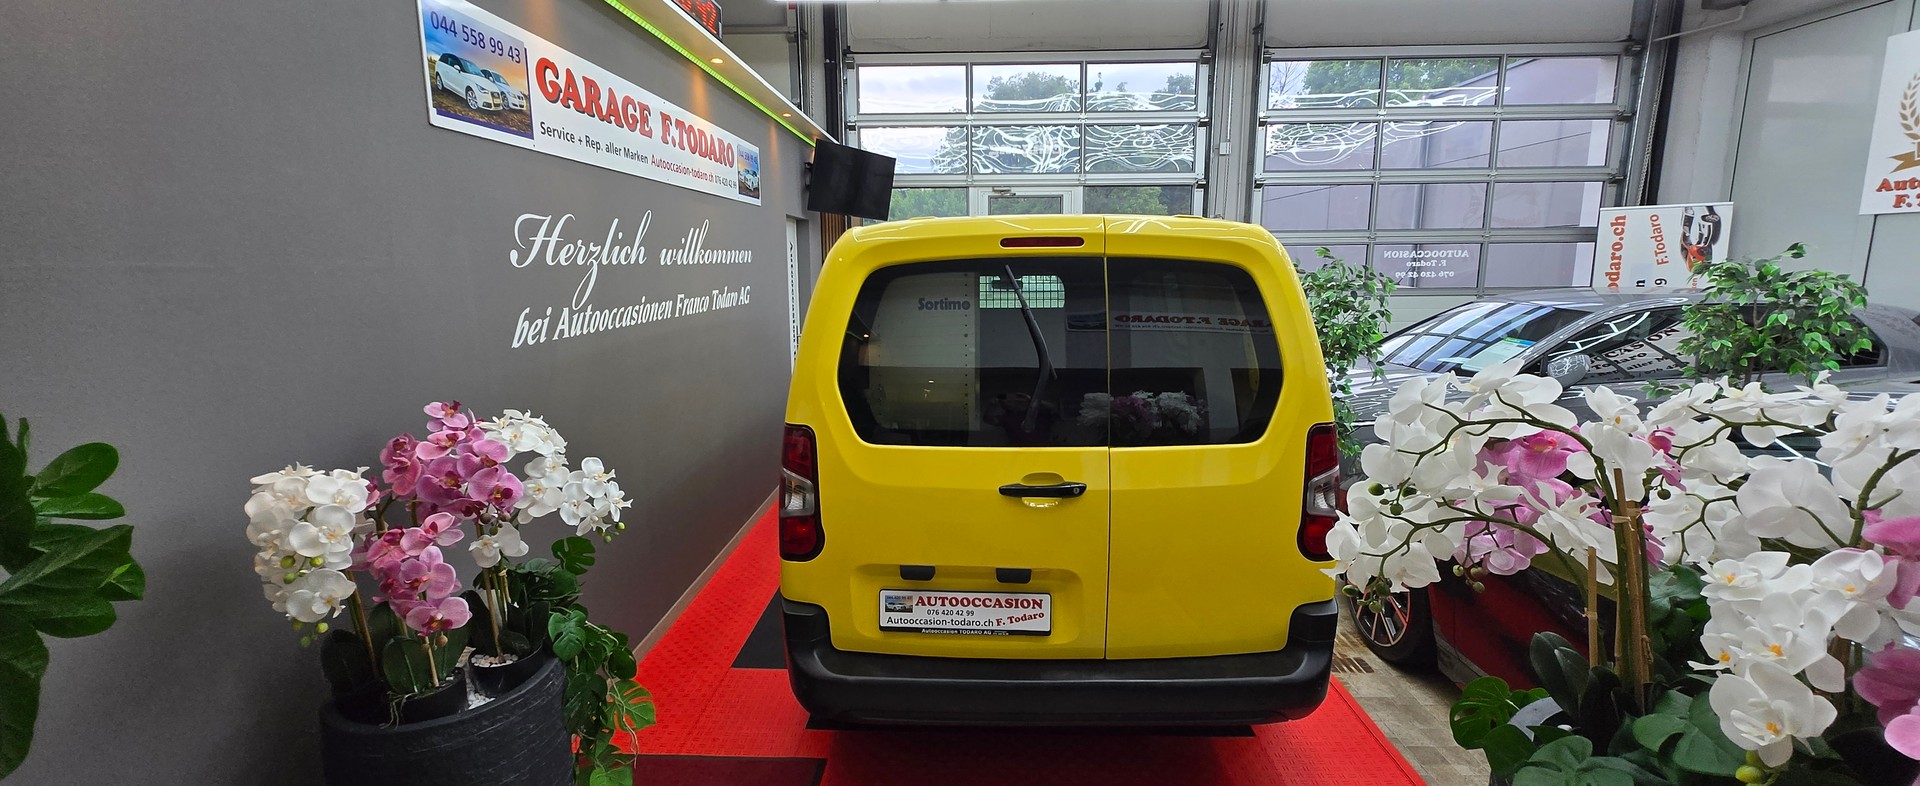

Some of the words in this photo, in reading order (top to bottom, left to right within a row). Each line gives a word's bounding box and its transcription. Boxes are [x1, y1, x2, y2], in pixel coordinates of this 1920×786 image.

[430, 11, 458, 38] 044
[461, 24, 486, 50] 558
[489, 37, 504, 57] 99
[507, 46, 521, 64] 43
[535, 57, 653, 139] GARAGE
[660, 111, 735, 169] F.TODARO
[540, 121, 576, 144] Service
[585, 135, 604, 153] Rep.
[605, 141, 622, 157] aller
[623, 146, 649, 164] Marken
[1875, 176, 1920, 193] Aut
[509, 209, 652, 311] Herzlich
[659, 218, 753, 266] willkommen
[511, 306, 553, 349] bei
[552, 295, 673, 341] Autooccasionen
[675, 293, 710, 318] Franco
[712, 285, 739, 311] Todaro
[738, 285, 751, 306] AG
[918, 297, 971, 311] Sortimo
[914, 595, 1043, 610] AUTOOCCASION
[941, 609, 954, 617] 420
[955, 609, 965, 617] 42
[886, 616, 994, 627] Autooccasion-todaro.ch
[995, 618, 1006, 627] F.
[1007, 612, 1045, 624] Todaro
